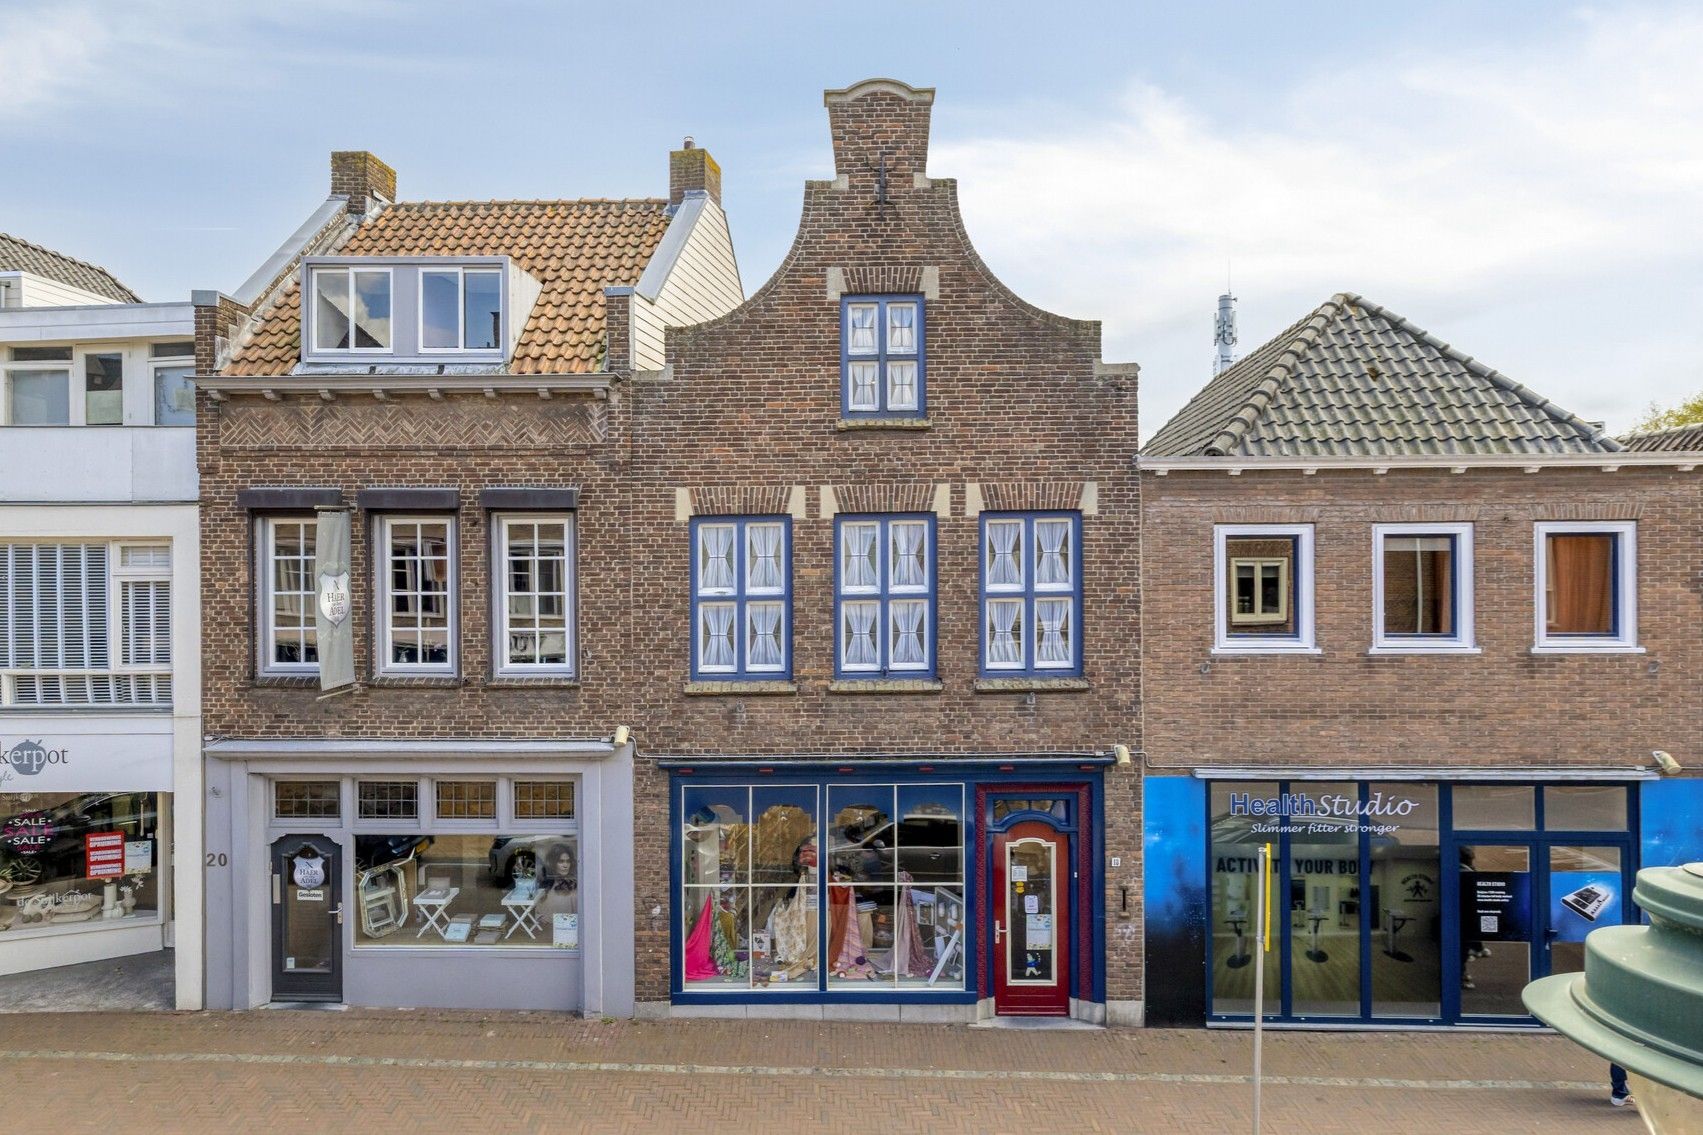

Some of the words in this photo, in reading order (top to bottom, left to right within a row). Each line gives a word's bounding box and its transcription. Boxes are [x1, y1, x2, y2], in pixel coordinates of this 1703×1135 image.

[13, 817, 47, 827] SALE
[1251, 823, 1305, 834] Slimmer
[1308, 823, 1342, 835] fitter
[1344, 824, 1400, 835] stronger
[13, 836, 46, 846] SALE
[206, 853, 228, 867] 20
[1295, 859, 1334, 874] YOUR
